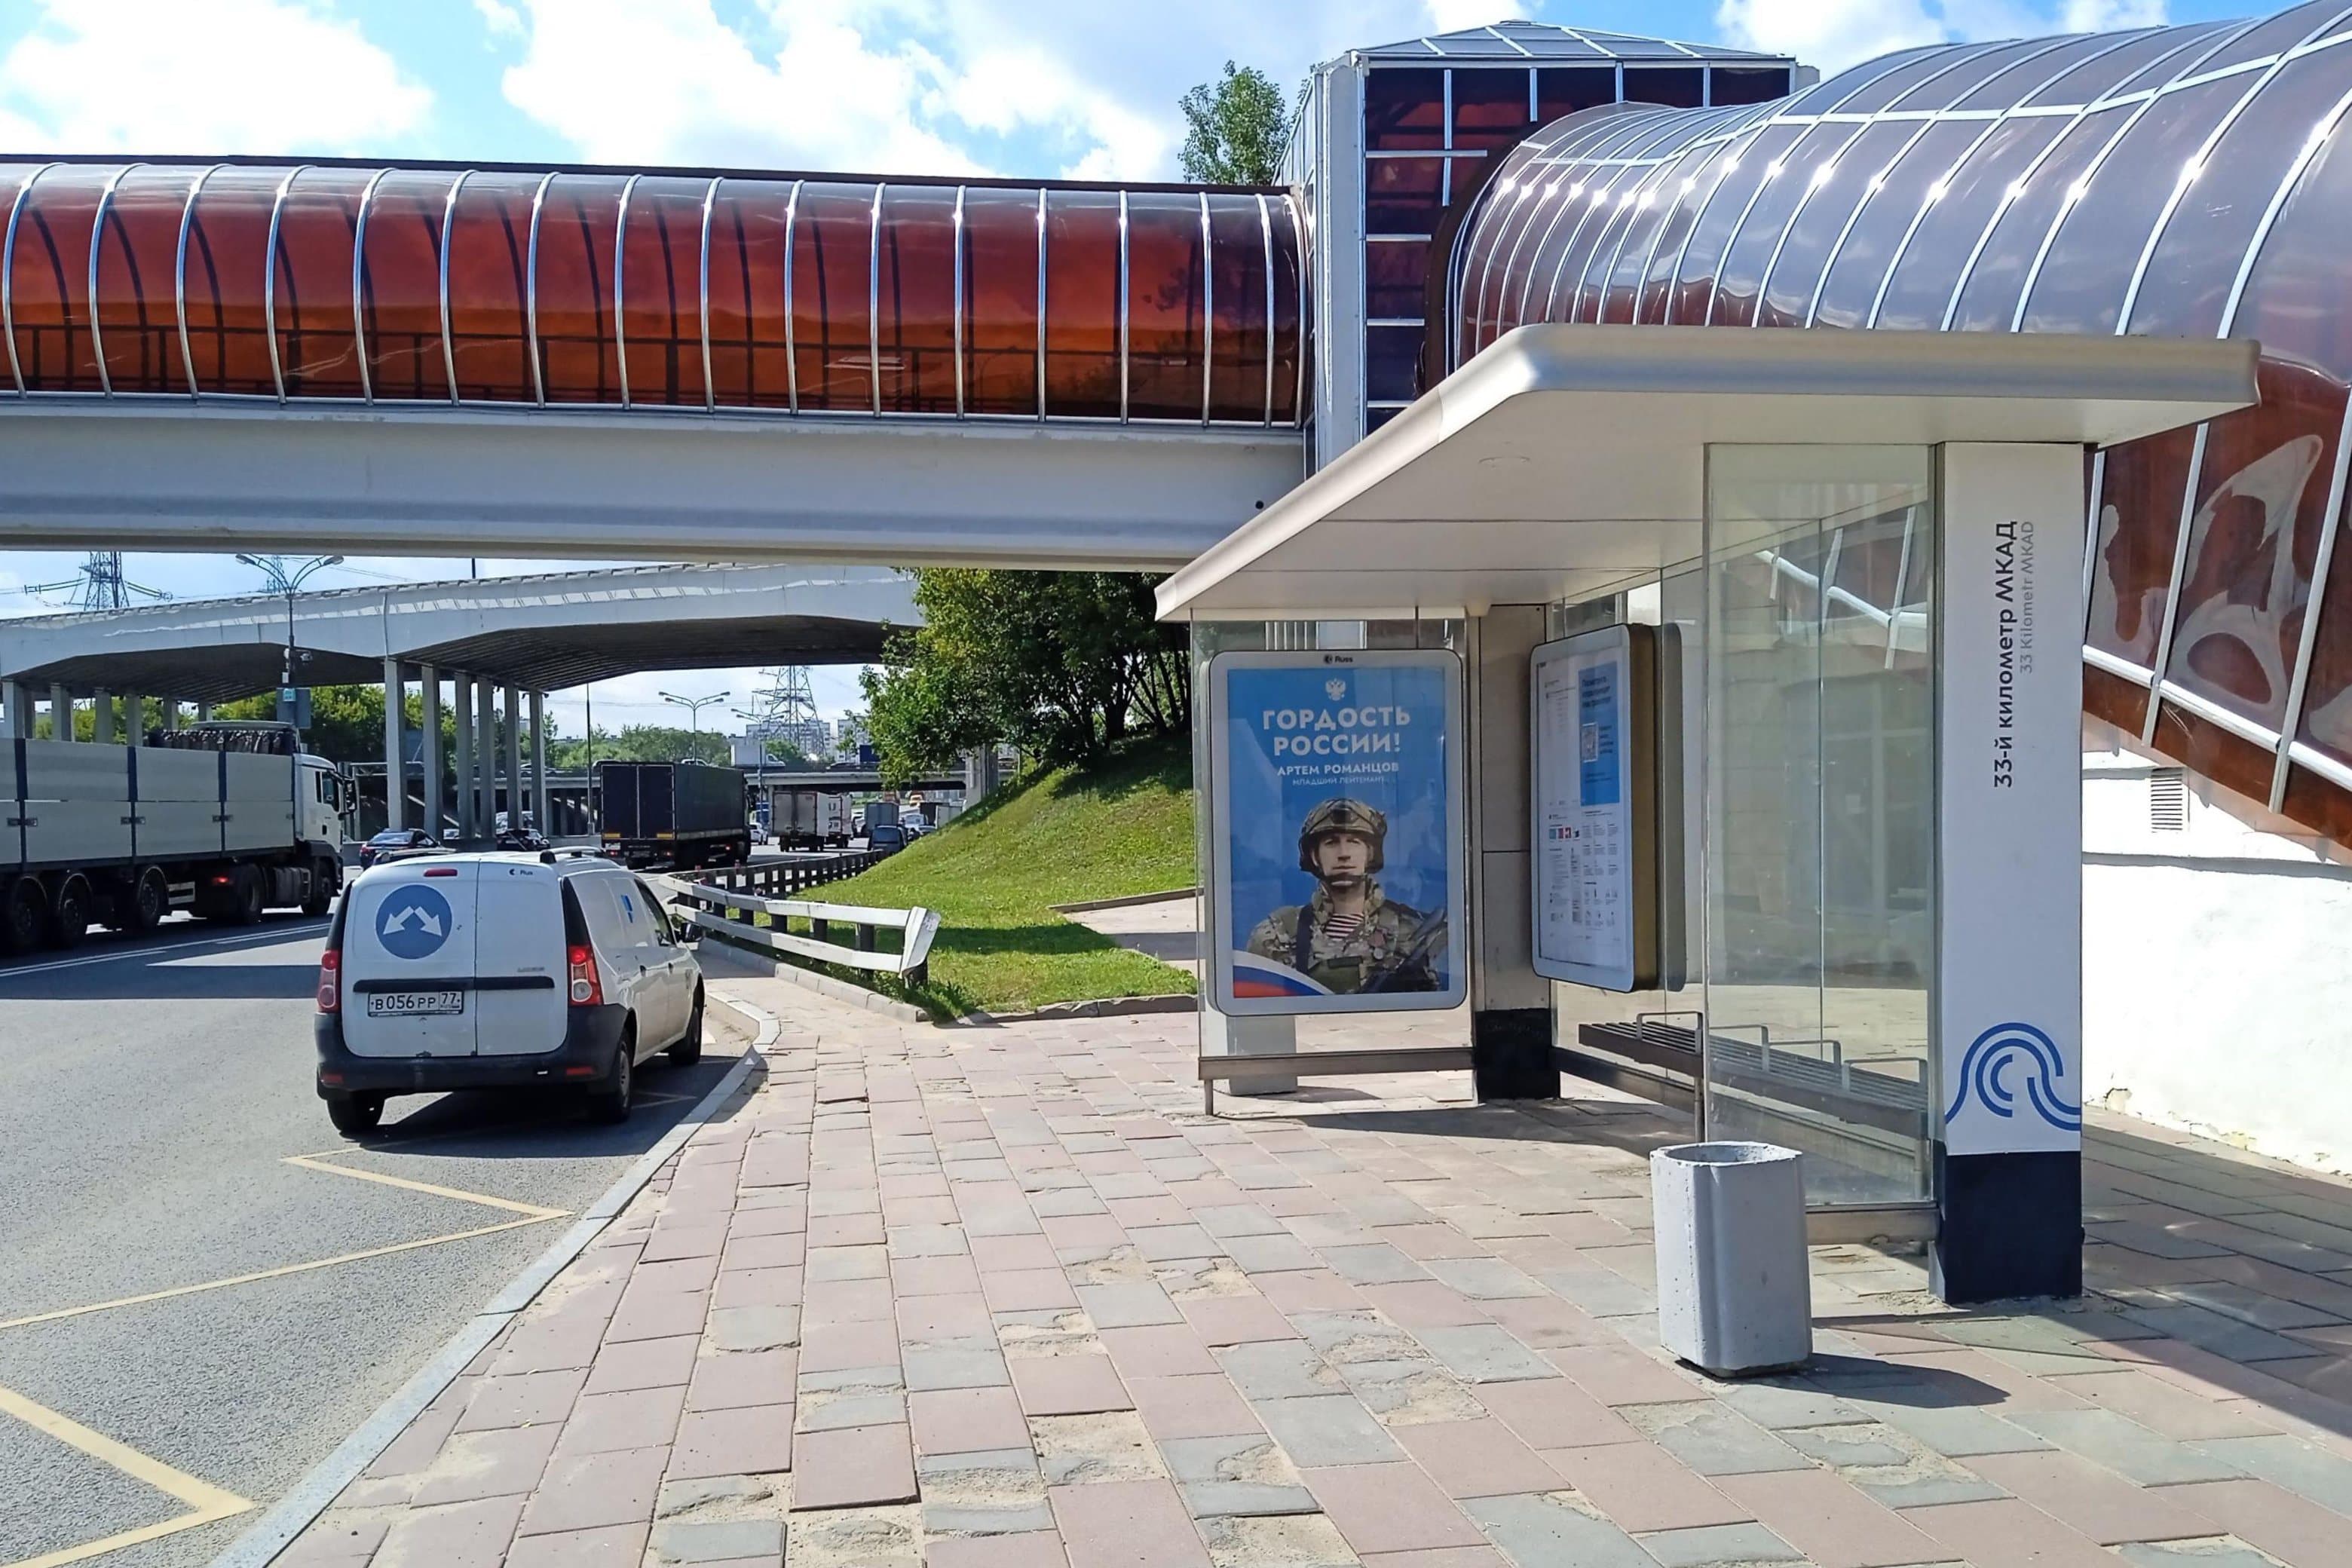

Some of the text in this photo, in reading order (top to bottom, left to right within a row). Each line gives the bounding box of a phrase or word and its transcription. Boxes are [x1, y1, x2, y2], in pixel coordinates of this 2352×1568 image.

[2020, 521, 2034, 675] 33 Kilometr MKAD
[1334, 655, 1354, 663] Russ
[1994, 521, 2017, 789] 33-й километр МКАД
[1262, 706, 1411, 731] ГОРДОСТЬ
[1273, 733, 1401, 756] РОССИИ!
[1276, 762, 1400, 776] АРТЕМ РОМАНЦОВ
